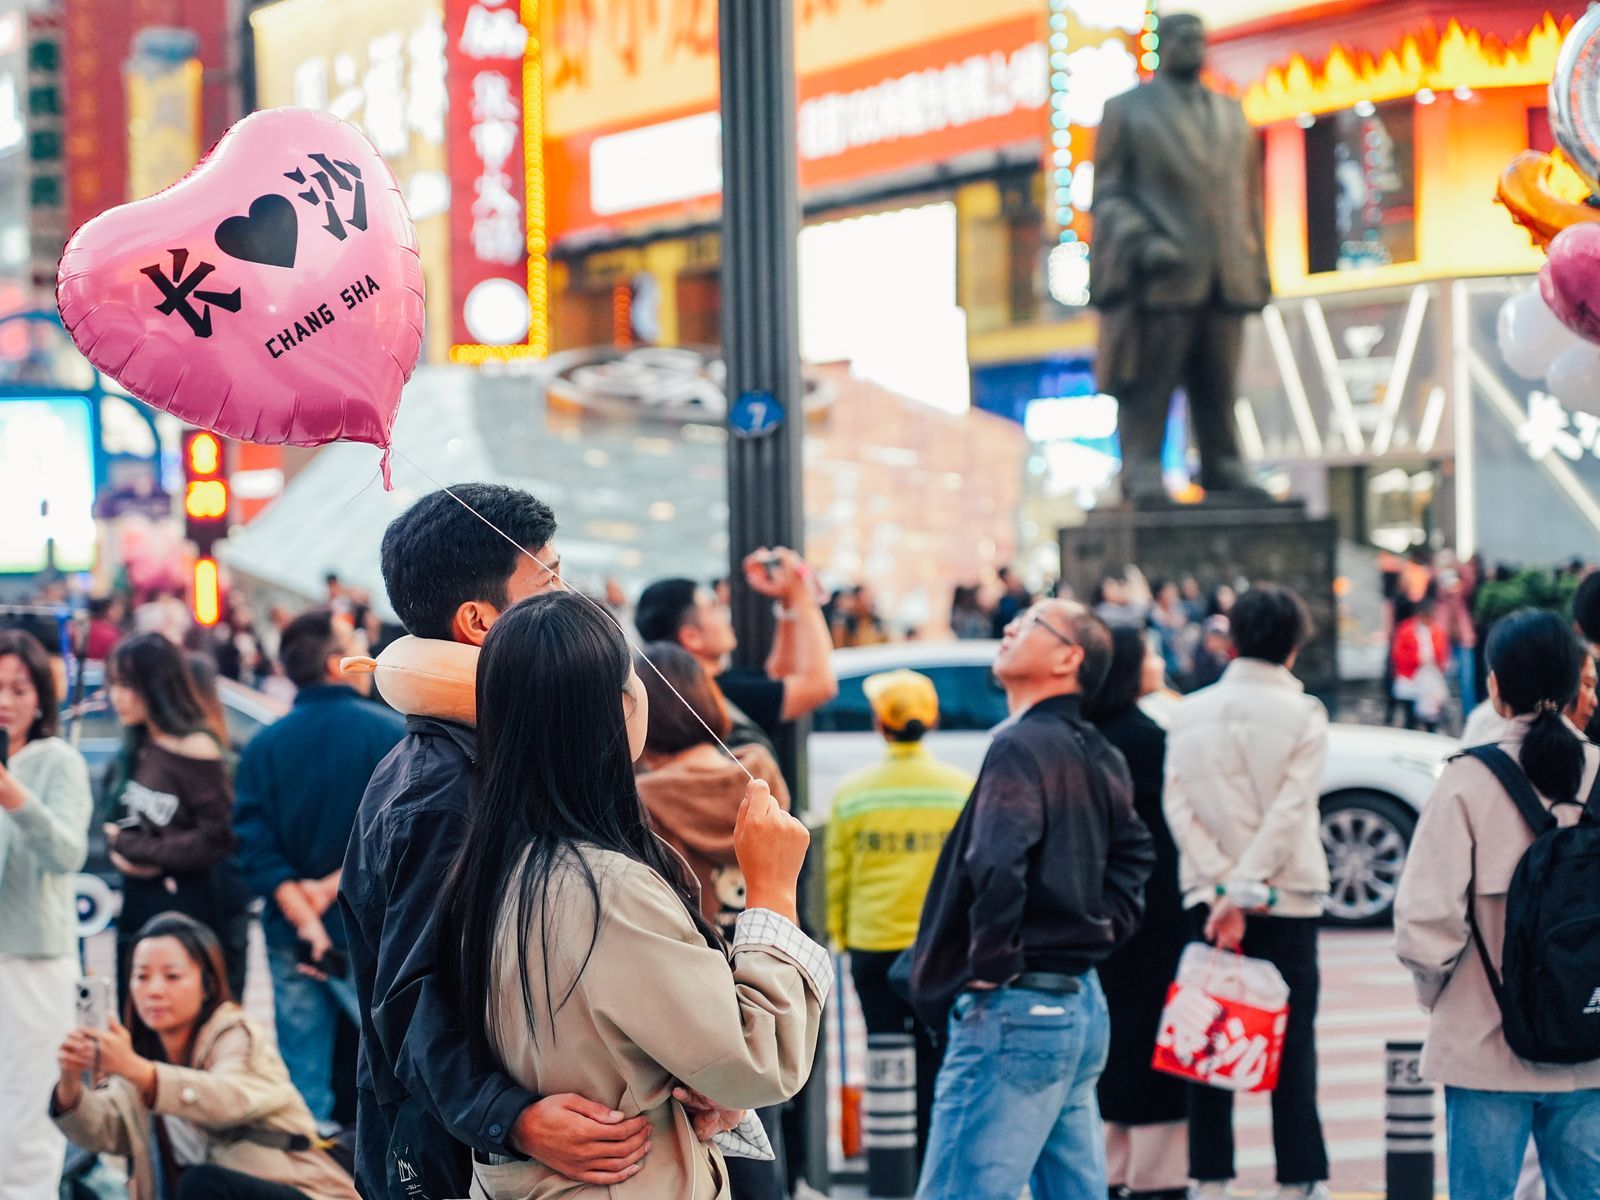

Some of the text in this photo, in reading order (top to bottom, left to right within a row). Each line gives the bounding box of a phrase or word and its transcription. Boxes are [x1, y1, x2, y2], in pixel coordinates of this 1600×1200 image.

[140, 248, 242, 339] 长
[283, 153, 368, 242] 沙
[264, 274, 381, 360] CHANG SHA
